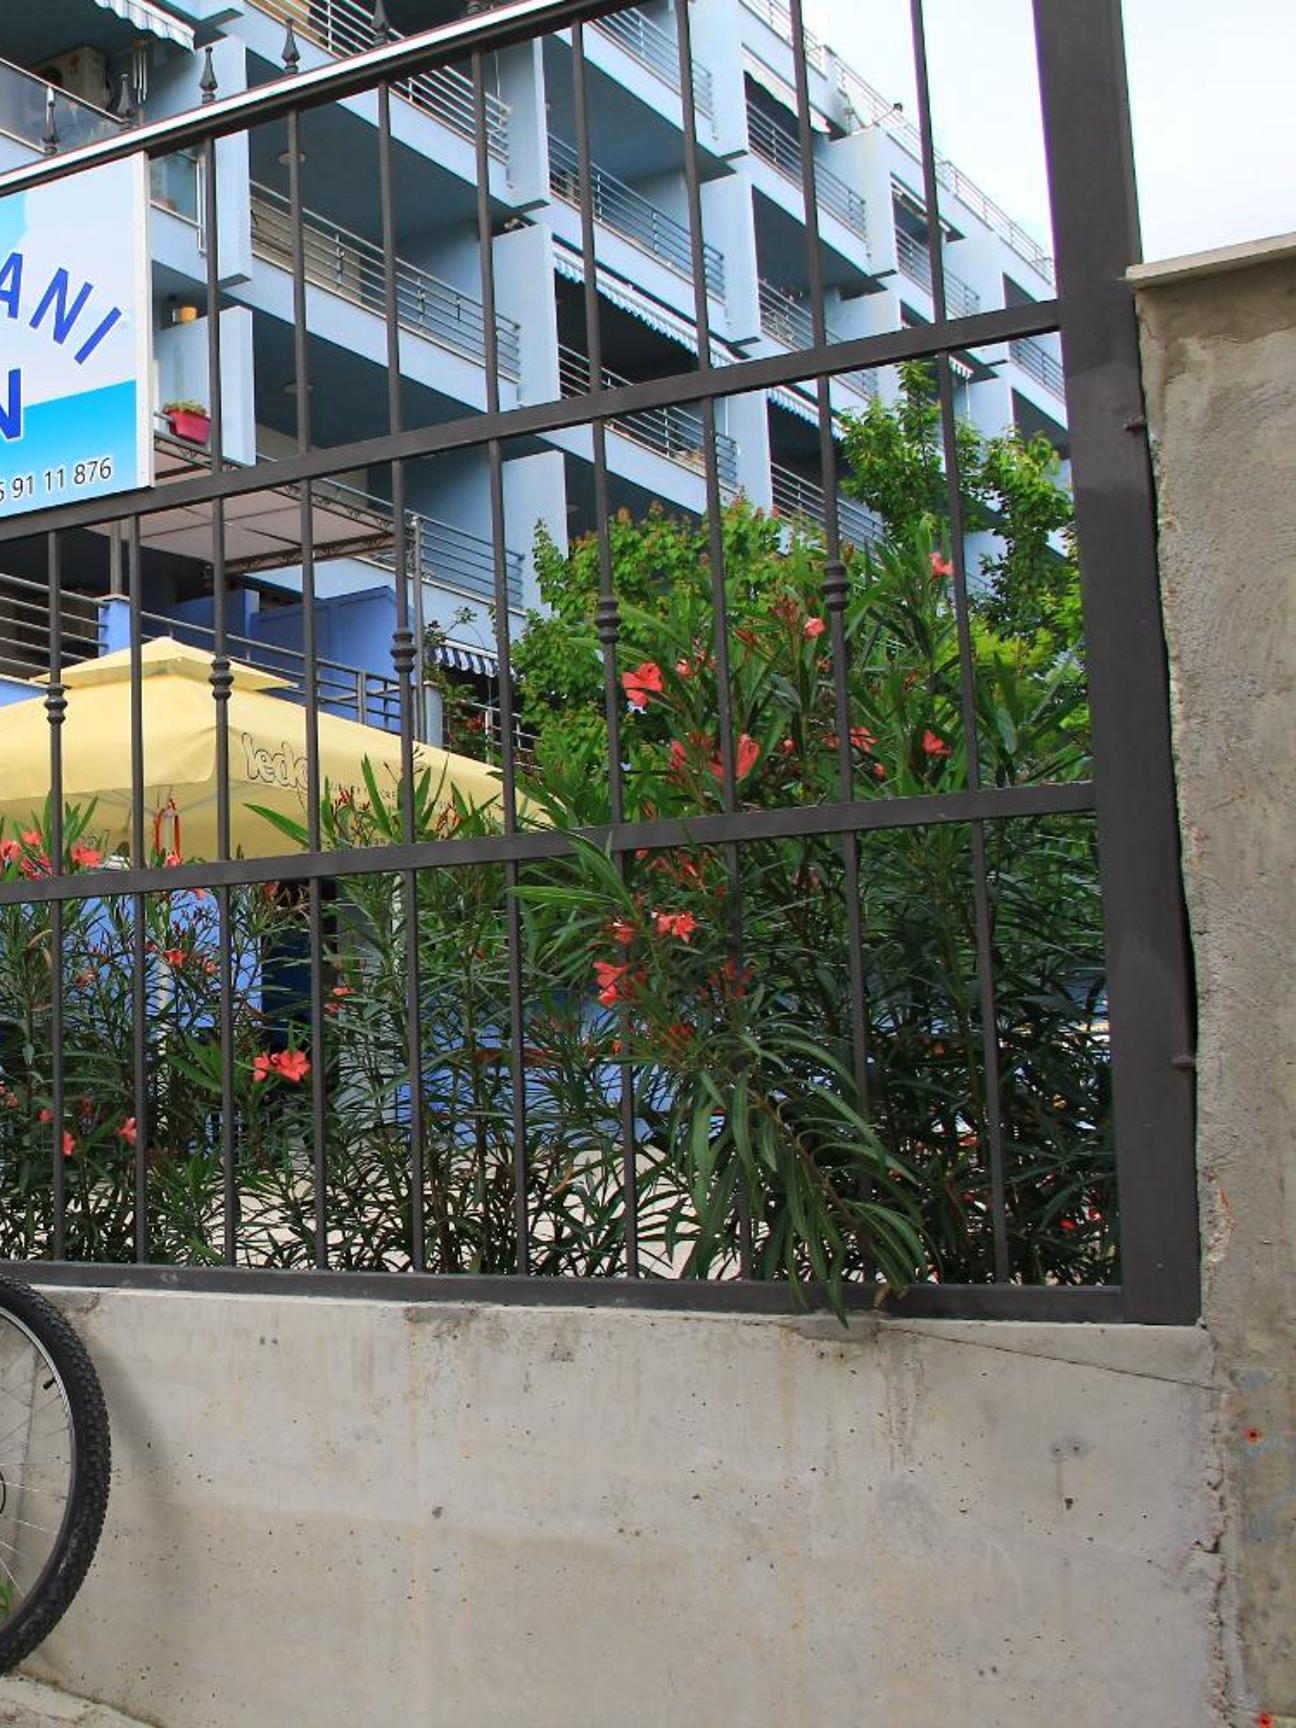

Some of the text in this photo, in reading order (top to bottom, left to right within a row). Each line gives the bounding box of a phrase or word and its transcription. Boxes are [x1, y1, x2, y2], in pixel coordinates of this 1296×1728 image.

[11, 475, 34, 499] 91
[44, 467, 65, 492] 11
[73, 457, 112, 486] 876
